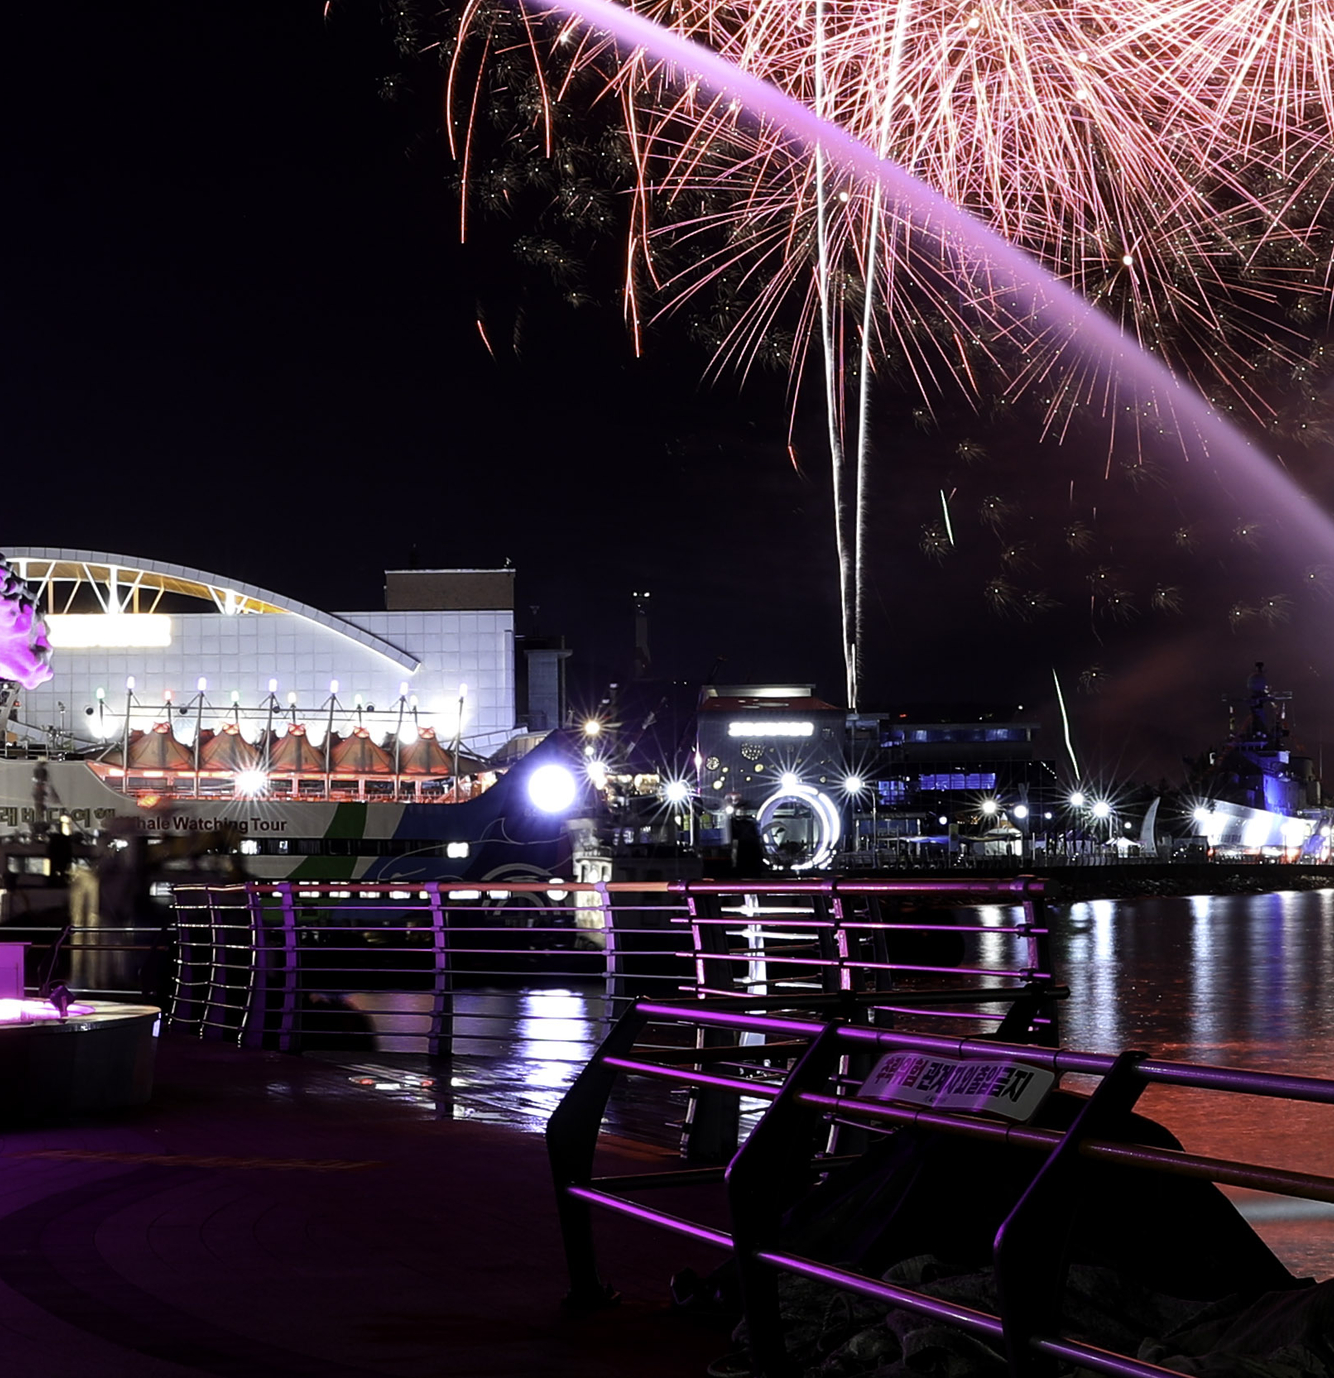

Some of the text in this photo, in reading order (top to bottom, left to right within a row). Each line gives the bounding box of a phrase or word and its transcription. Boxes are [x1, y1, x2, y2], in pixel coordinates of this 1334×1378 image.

[121, 816, 287, 833] hale Watching Tour
